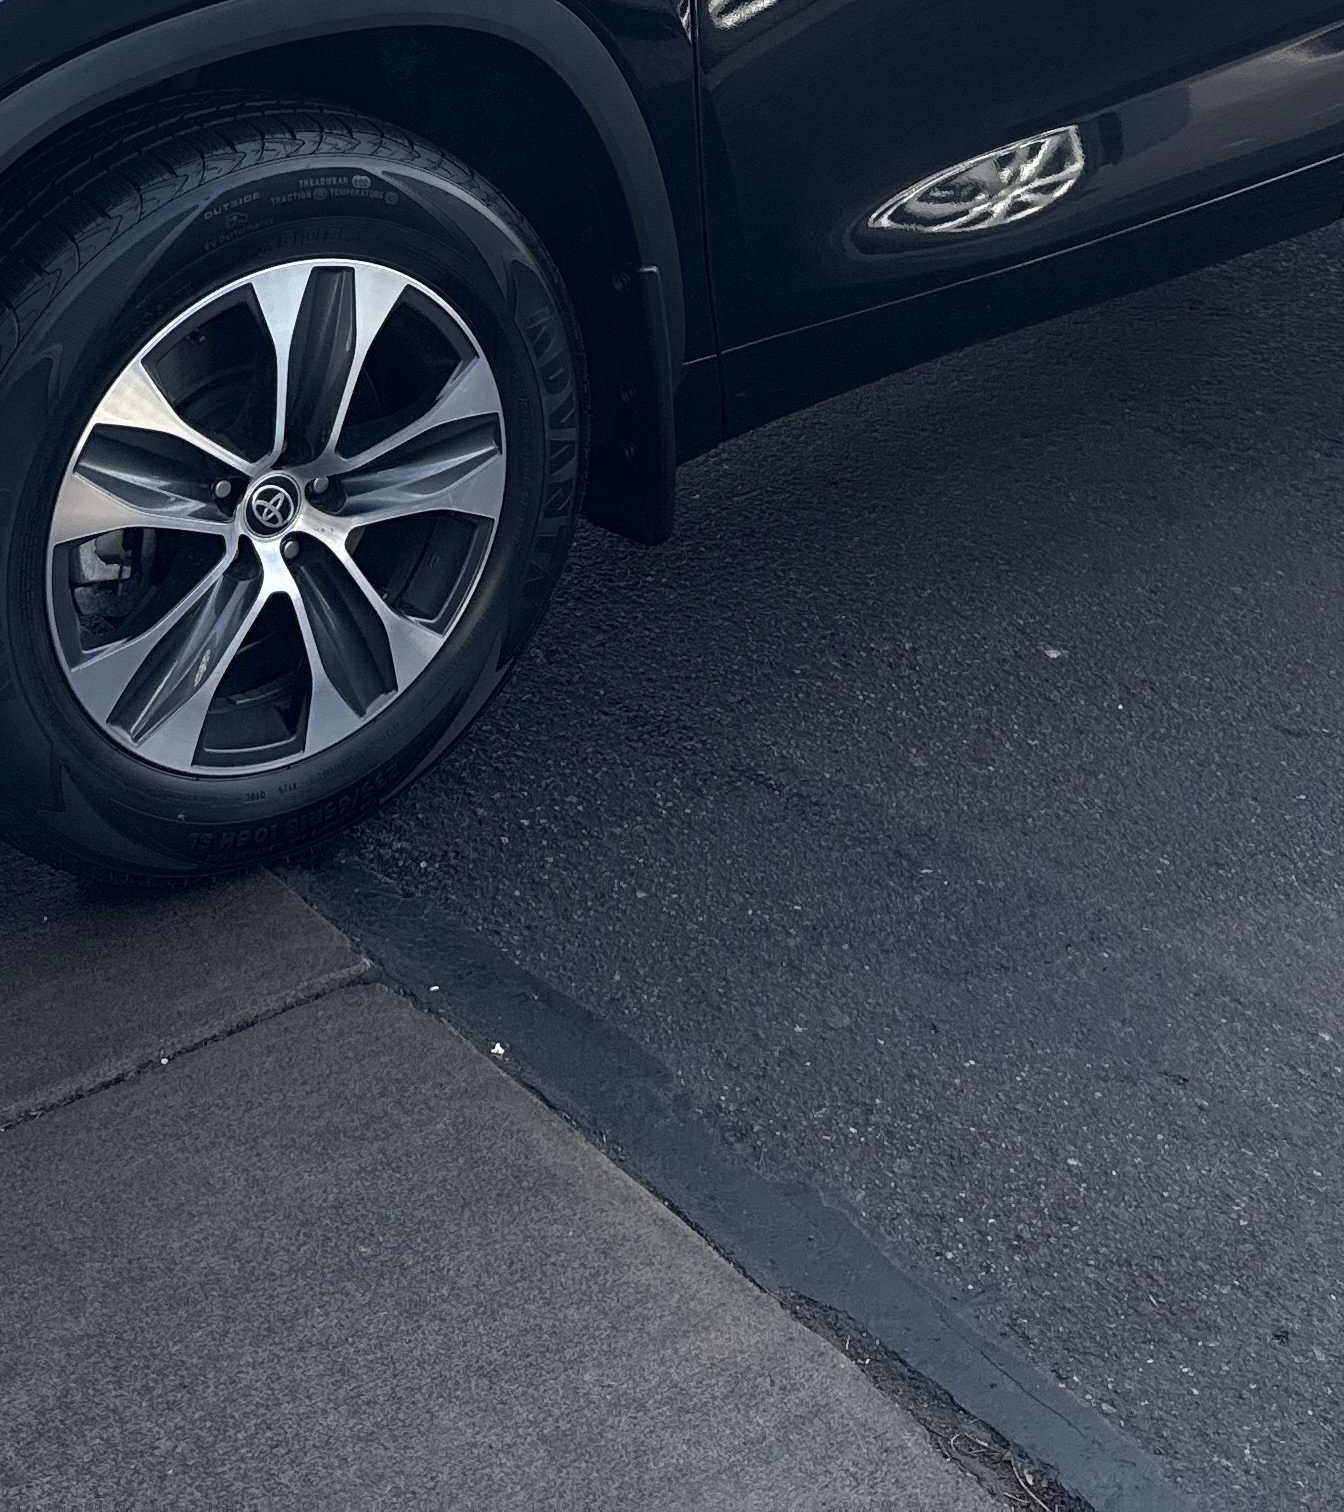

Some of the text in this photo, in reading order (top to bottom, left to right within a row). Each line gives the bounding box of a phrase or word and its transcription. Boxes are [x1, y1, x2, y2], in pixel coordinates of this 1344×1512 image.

[298, 176, 349, 188] TREADWEAR
[203, 191, 261, 221] OUTSIDE
[270, 190, 312, 206] TRACTION
[329, 188, 384, 200] TEMPERATURE
